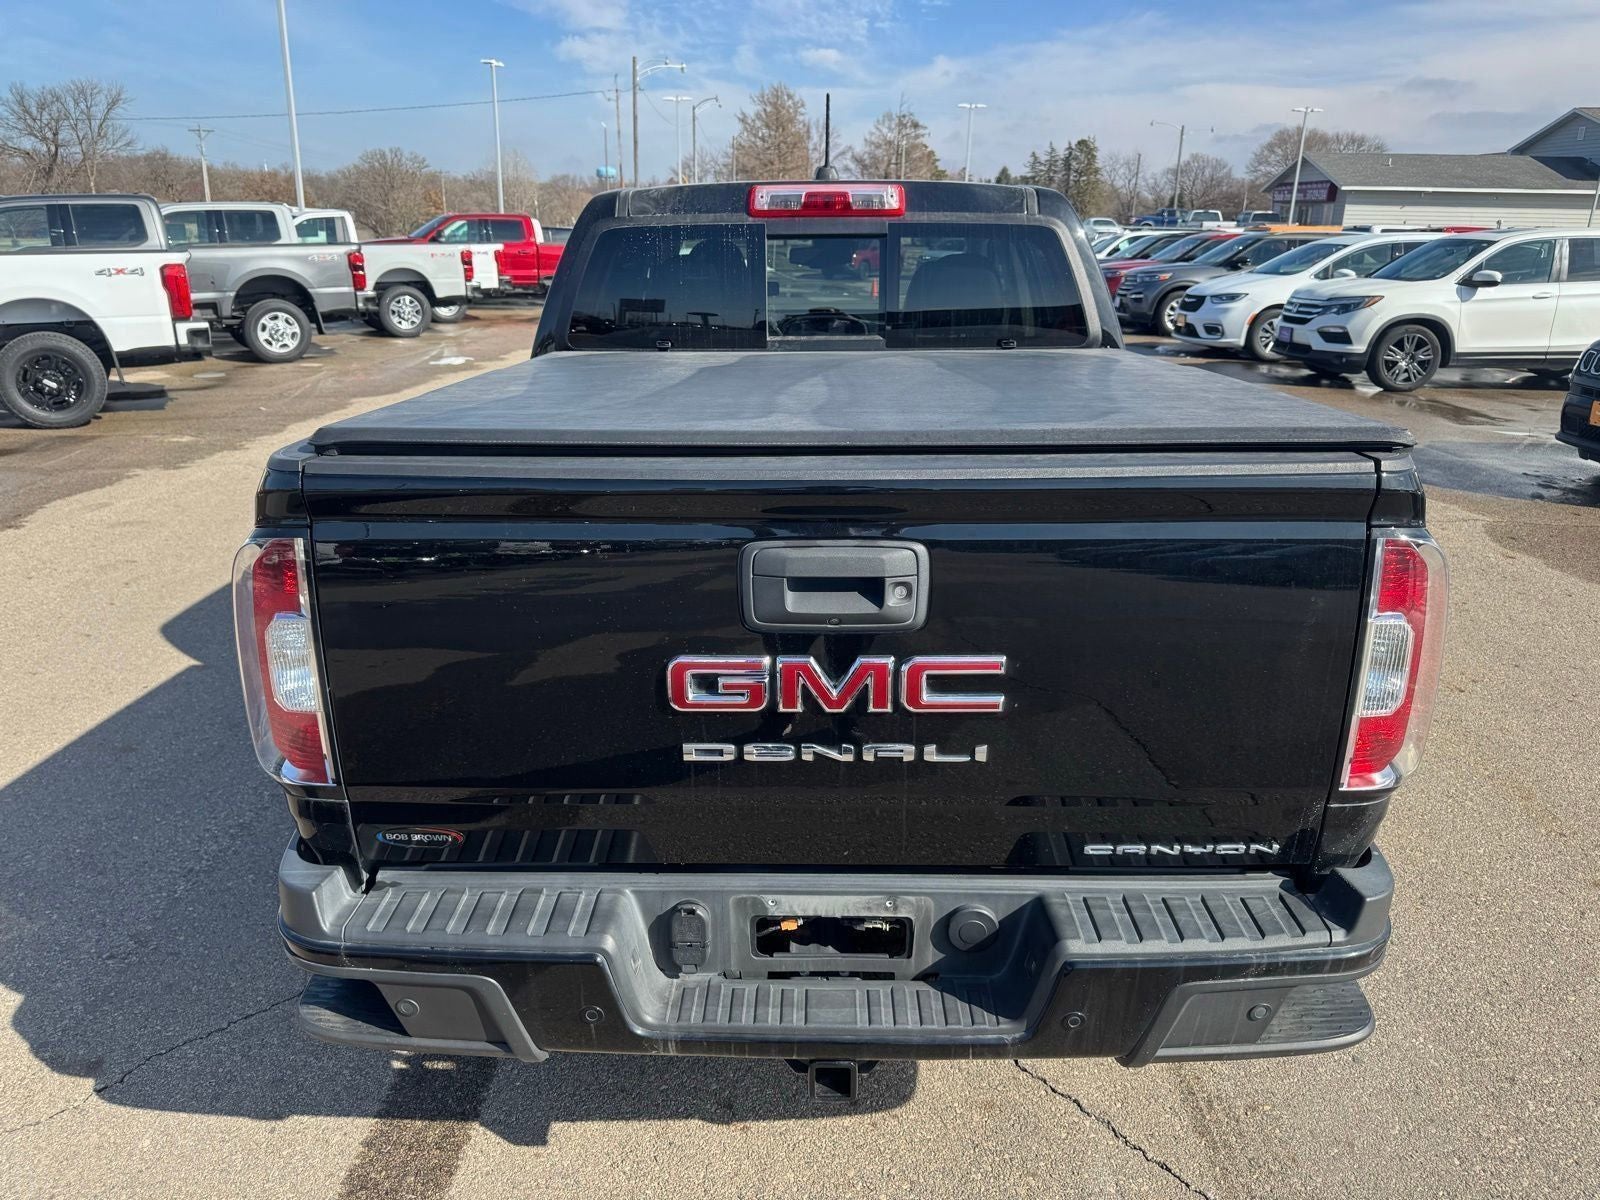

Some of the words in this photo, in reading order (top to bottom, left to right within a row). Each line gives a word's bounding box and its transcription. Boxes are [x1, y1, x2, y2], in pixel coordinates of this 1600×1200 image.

[667, 655, 1007, 713] GMC
[682, 743, 988, 762] DENALI
[385, 833, 408, 841] BOB
[411, 833, 452, 843] BROWN
[1083, 843, 1281, 855] CANYON
